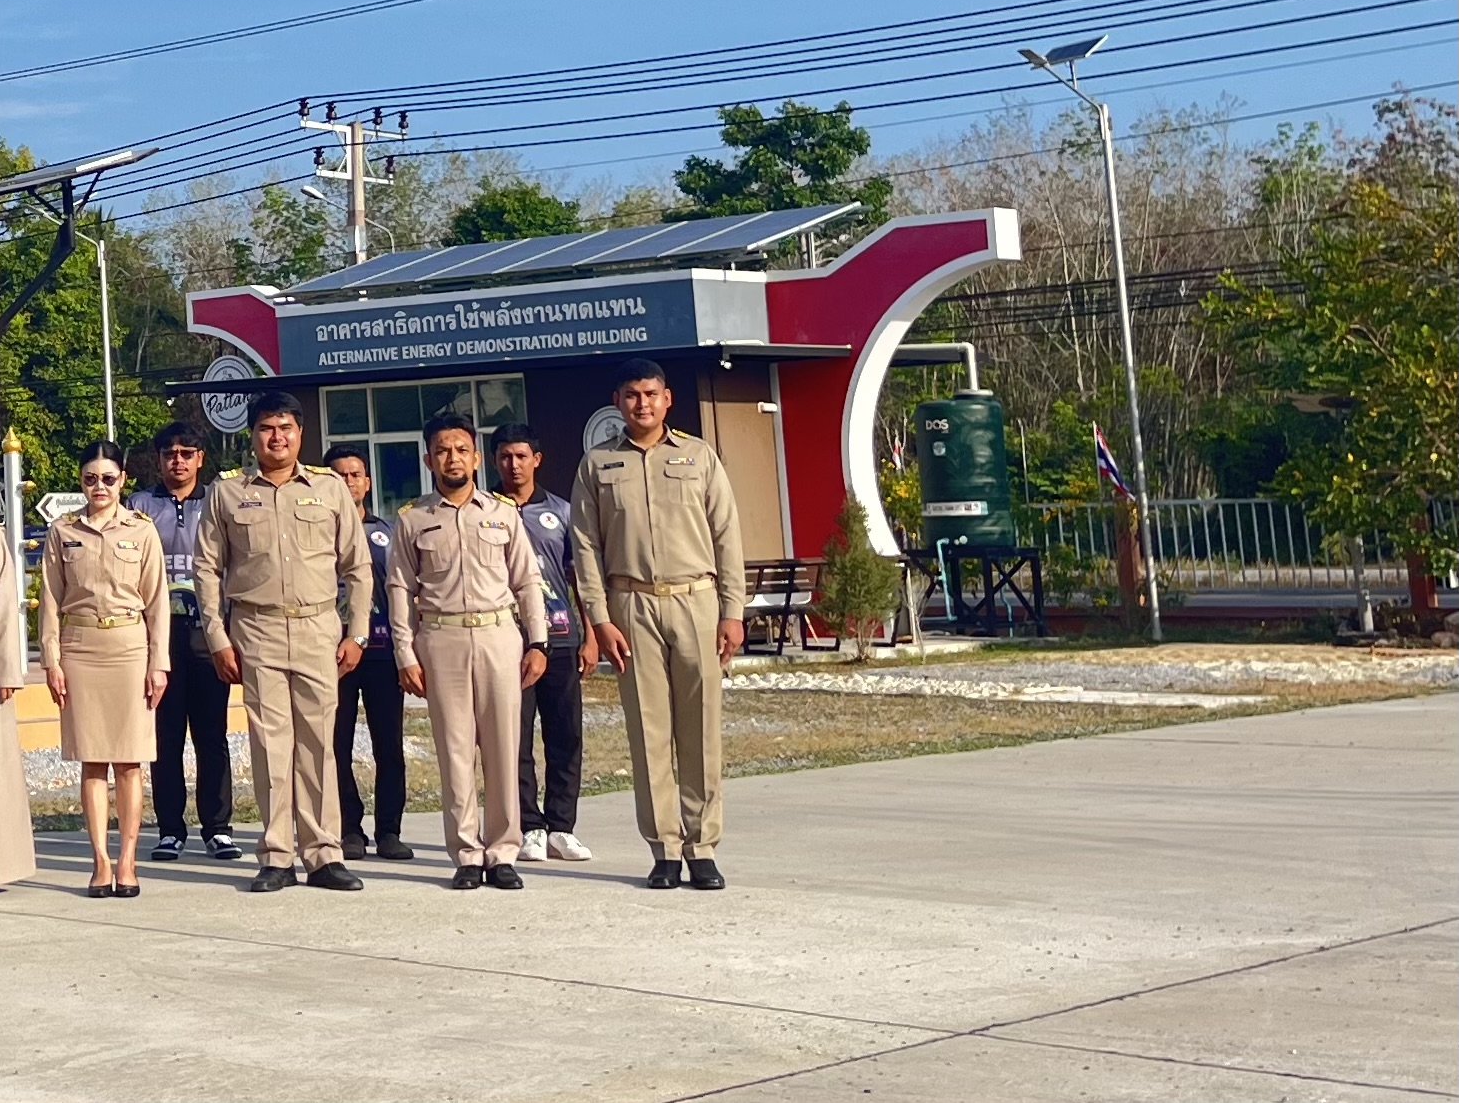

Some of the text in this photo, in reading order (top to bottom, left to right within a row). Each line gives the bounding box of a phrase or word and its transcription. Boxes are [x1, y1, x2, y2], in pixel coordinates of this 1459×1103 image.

[315, 297, 646, 342] อาคารสาธิตการใช้พลังงานทดแทน
[318, 327, 648, 366] ALTERNATIVE ENERGY DEMONSTRATION BUILDING
[925, 419, 949, 430] DOS
